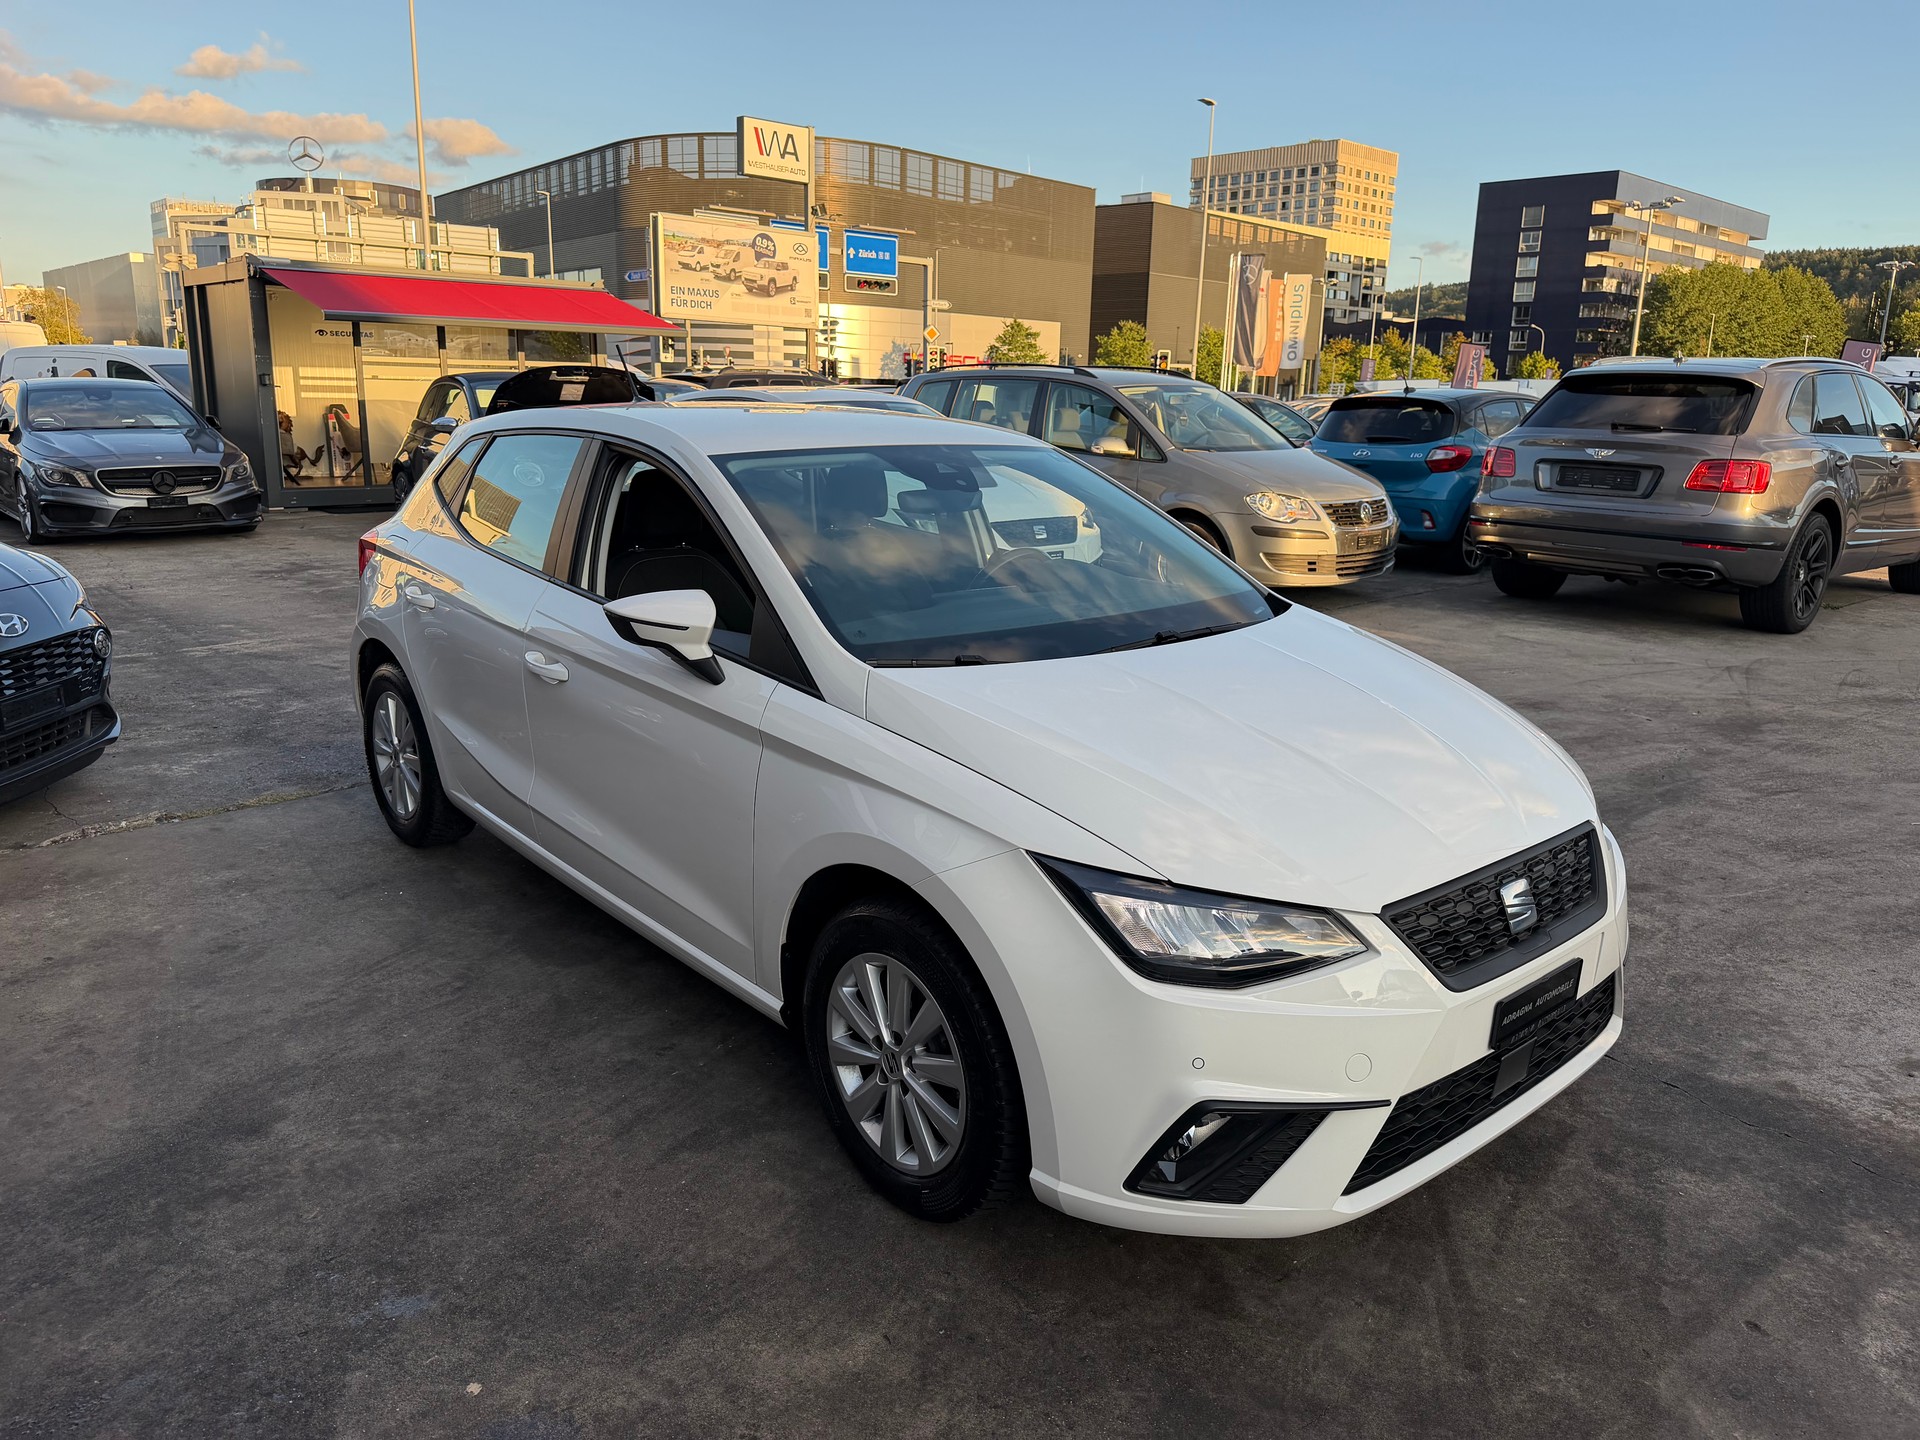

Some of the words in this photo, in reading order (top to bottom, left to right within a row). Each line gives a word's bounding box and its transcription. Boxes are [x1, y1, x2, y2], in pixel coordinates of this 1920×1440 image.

[748, 160, 789, 173] WESTHAUSER
[790, 168, 806, 176] AUTO
[755, 236, 775, 251] 0.9%
[670, 285, 686, 296] EIN
[687, 287, 720, 299] MAXUS
[670, 296, 688, 307] FÜR
[690, 299, 713, 310] DICH
[1287, 283, 1305, 361] OMNIplus
[329, 330, 374, 338] SECUTAS
[1501, 1002, 1533, 1027] ADRAGNA
[1535, 978, 1575, 1008] AUTOMOBILE
